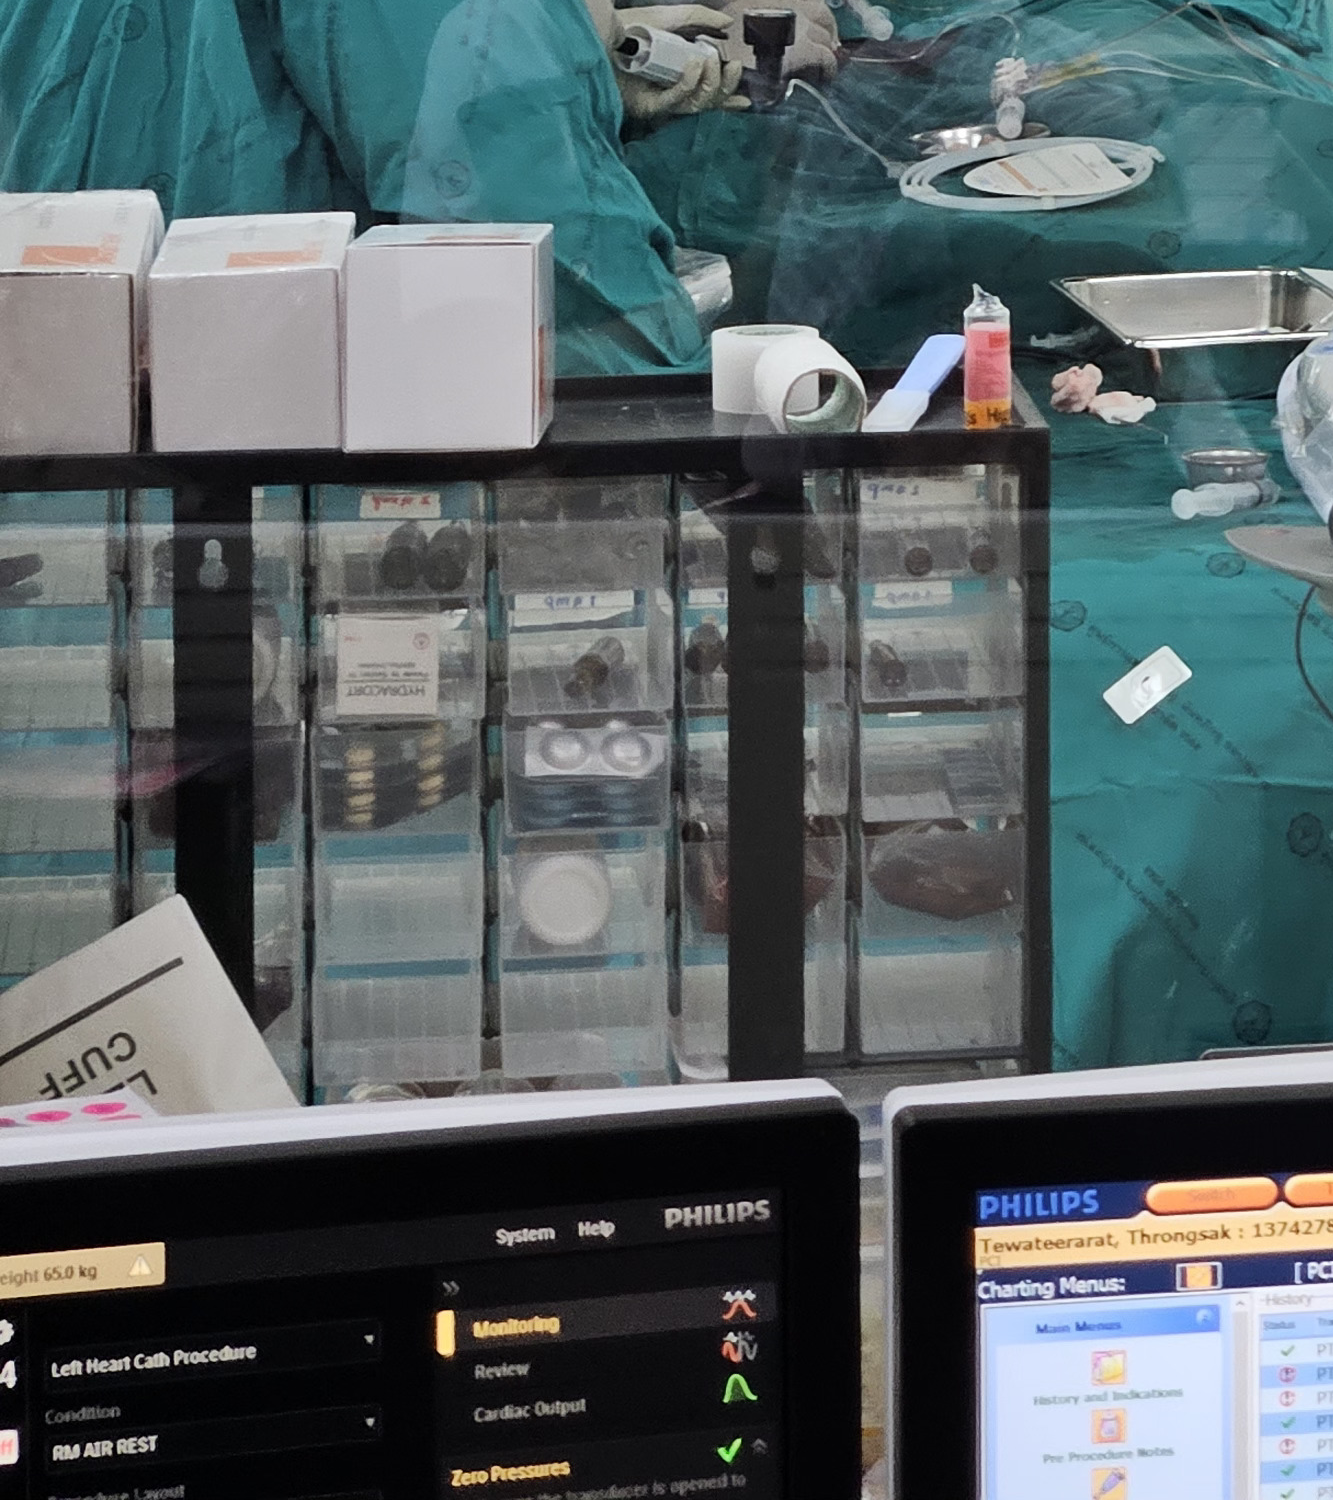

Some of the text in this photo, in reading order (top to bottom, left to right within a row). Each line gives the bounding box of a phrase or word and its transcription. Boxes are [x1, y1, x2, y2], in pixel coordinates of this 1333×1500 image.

[39, 1031, 138, 1100] CUFF
[664, 1199, 771, 1229] PHILIPS
[979, 1189, 1099, 1220] PHILIPS
[496, 1219, 616, 1247] System Help
[979, 1232, 1119, 1256] Tewateerarat,
[1127, 1225, 1231, 1246] Throngsak
[43, 1266, 74, 1282] 65.0
[78, 1264, 98, 1282] kg
[977, 1276, 1127, 1302] Charting Menus:
[1265, 1293, 1313, 1308] History
[473, 1316, 561, 1338] Monitoring
[1075, 1319, 1122, 1333] Menus
[51, 1343, 257, 1379] Left Heart Cath Procedure
[475, 1362, 531, 1380] Review
[1084, 1390, 1109, 1402] and
[1113, 1387, 1183, 1401] Indications
[46, 1404, 121, 1426] Condition
[473, 1398, 587, 1424] Cardiac Output
[52, 1435, 158, 1461] RM AIR REST
[1043, 1446, 1175, 1464] Pre Procedure Notes
[451, 1462, 571, 1487] Zero Pressures
[652, 1481, 667, 1495] is
[669, 1473, 728, 1496] opened
[731, 1473, 747, 1488] to
